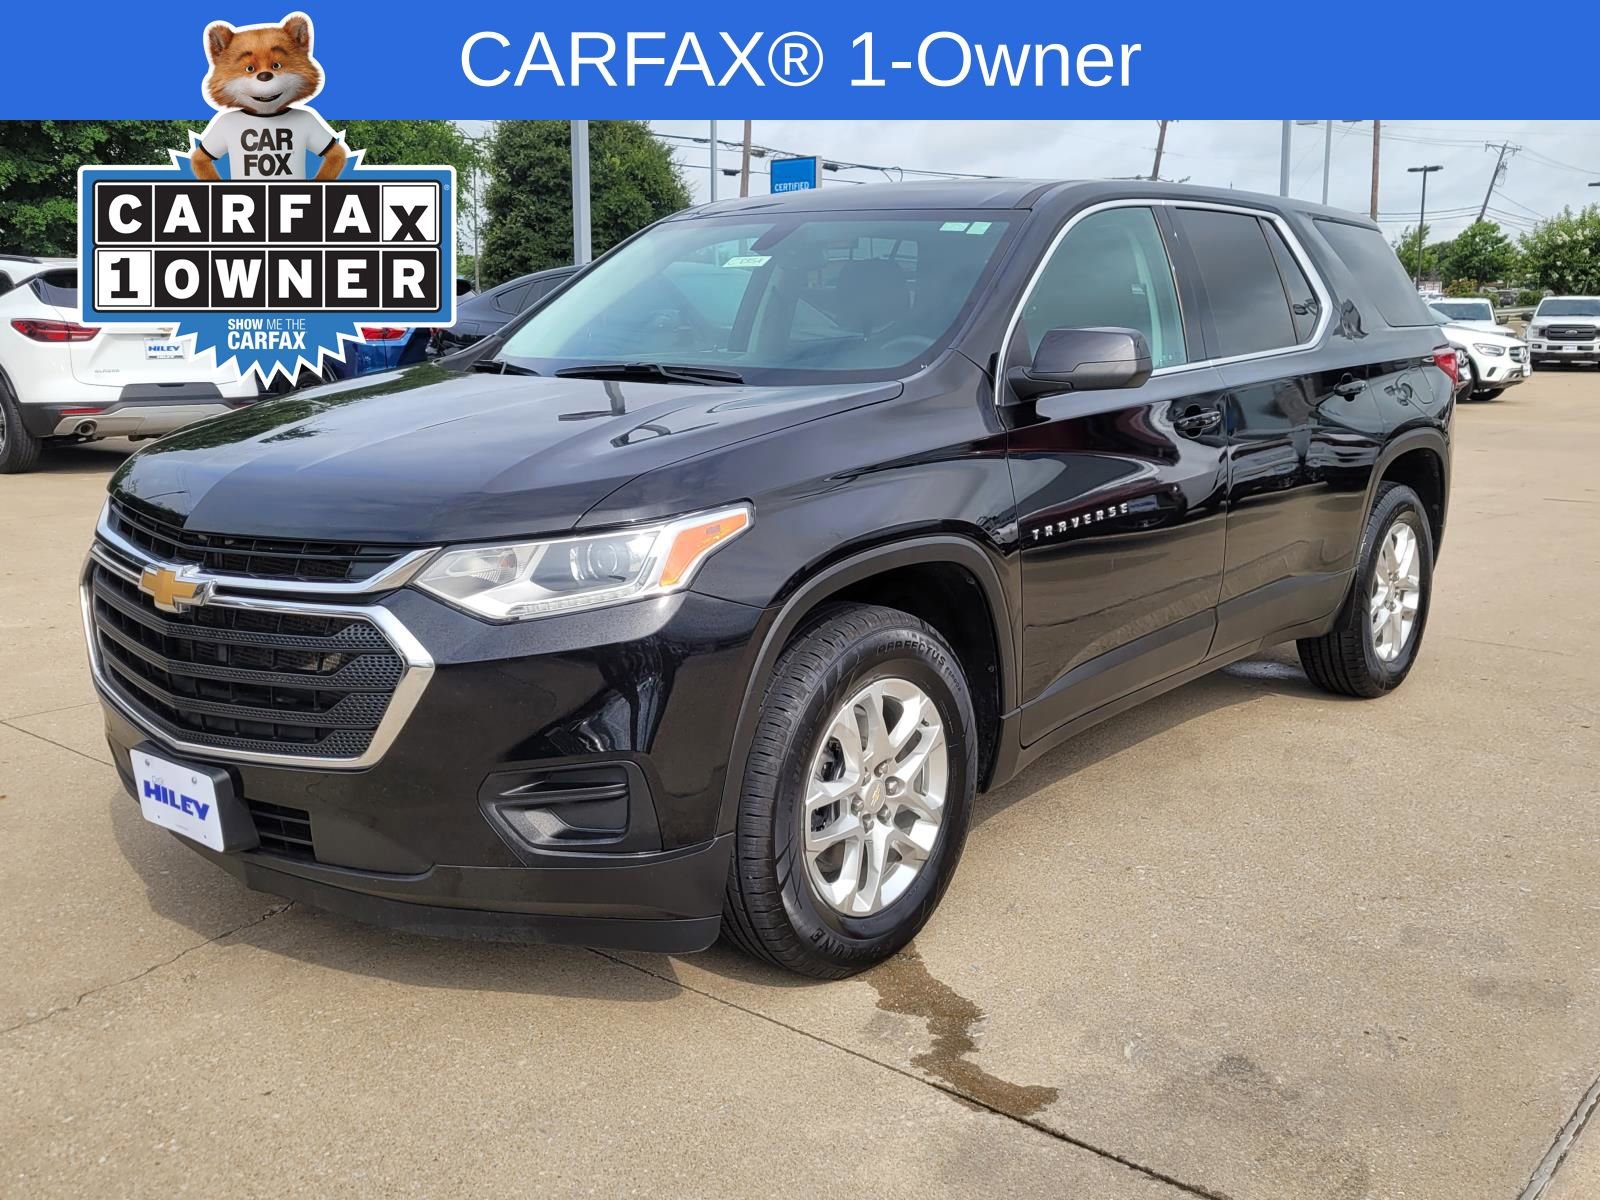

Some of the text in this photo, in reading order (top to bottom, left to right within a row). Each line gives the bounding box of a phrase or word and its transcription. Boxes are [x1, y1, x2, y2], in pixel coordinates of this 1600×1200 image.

[774, 181, 810, 192] CERTIFIED
[1032, 503, 1128, 541] TRAVERSE
[143, 779, 210, 821] HILEY
